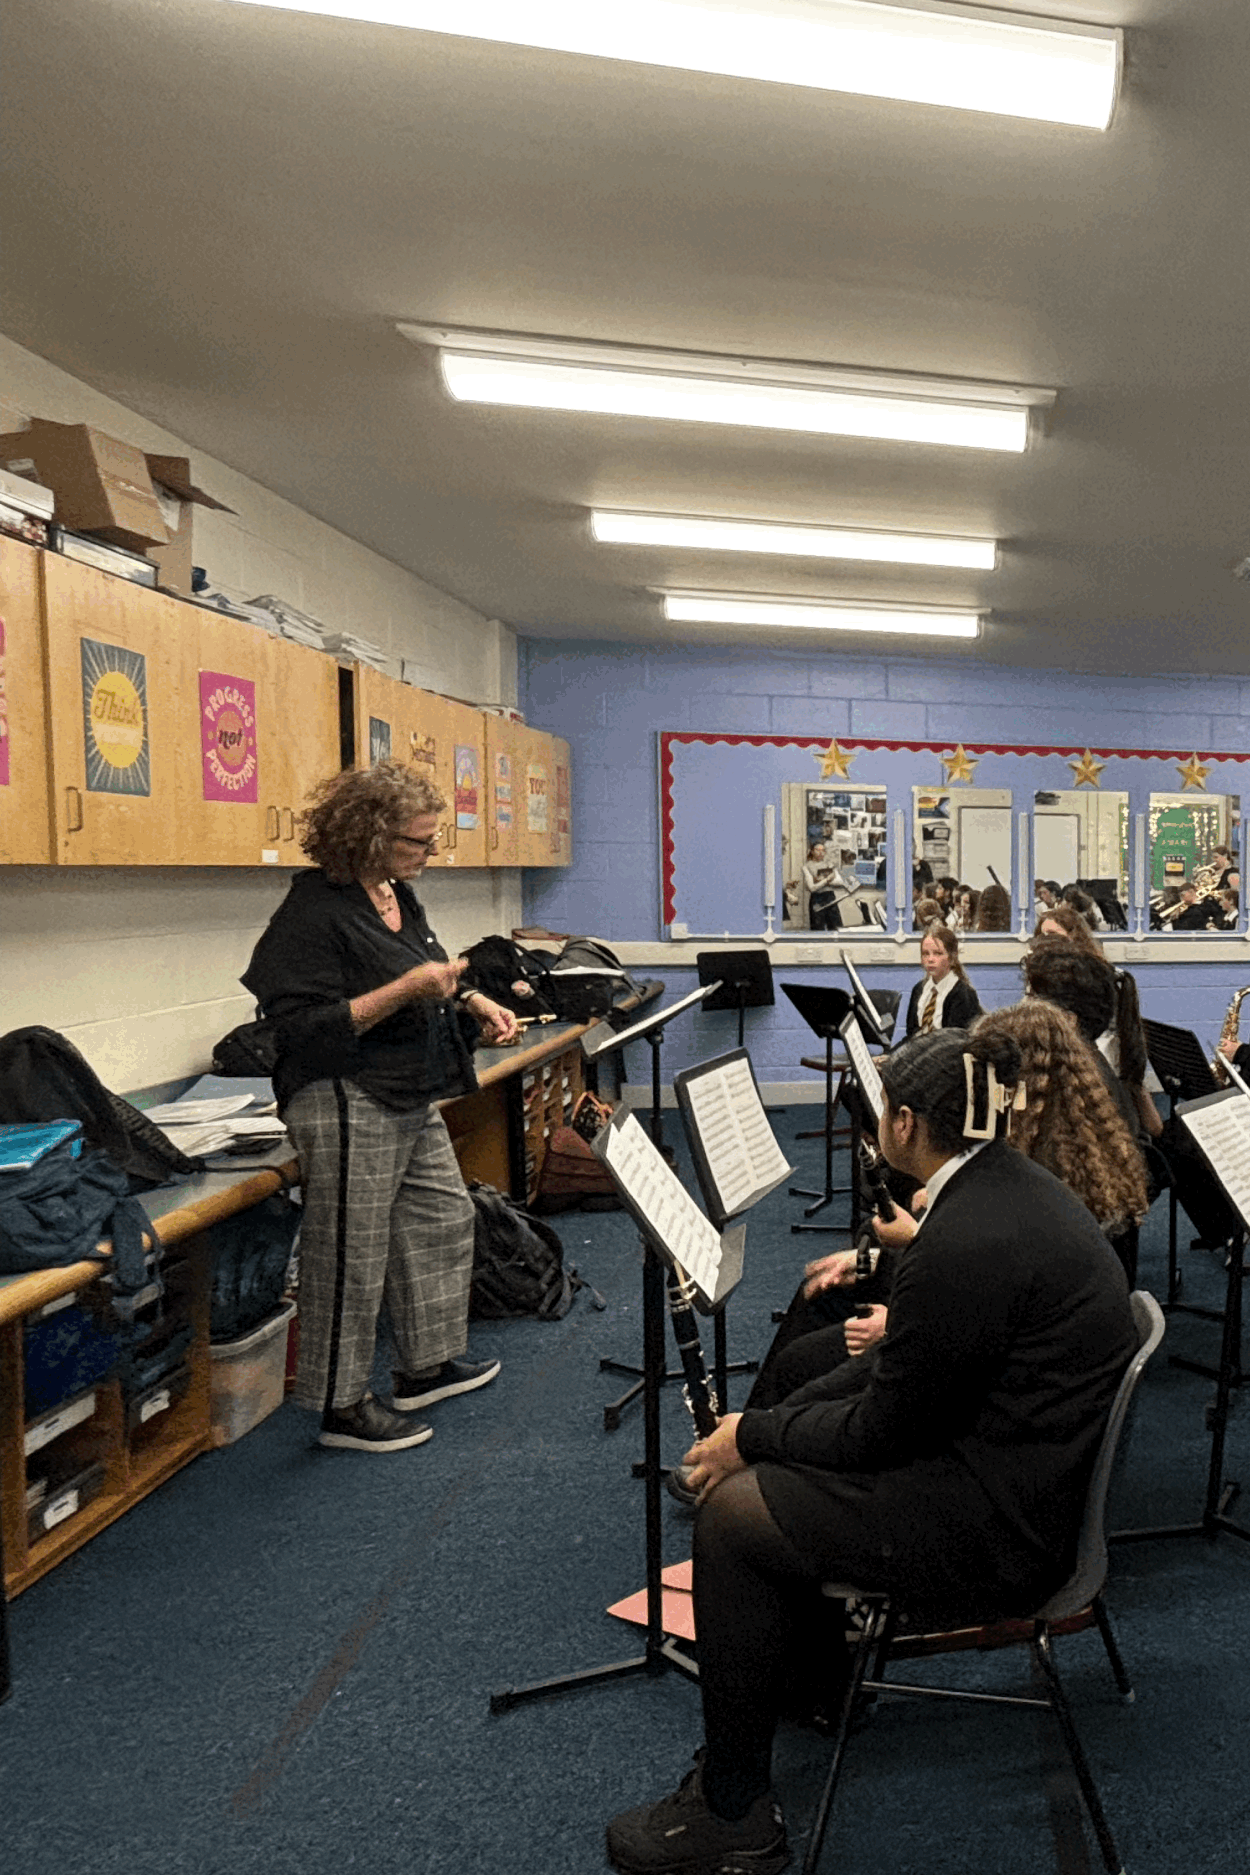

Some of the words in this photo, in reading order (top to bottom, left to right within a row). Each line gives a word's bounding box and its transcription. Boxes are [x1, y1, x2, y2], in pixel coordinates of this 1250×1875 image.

[204, 685, 254, 728] PROGRESS
[217, 728, 244, 750] not
[205, 748, 257, 791] PERFECTION
